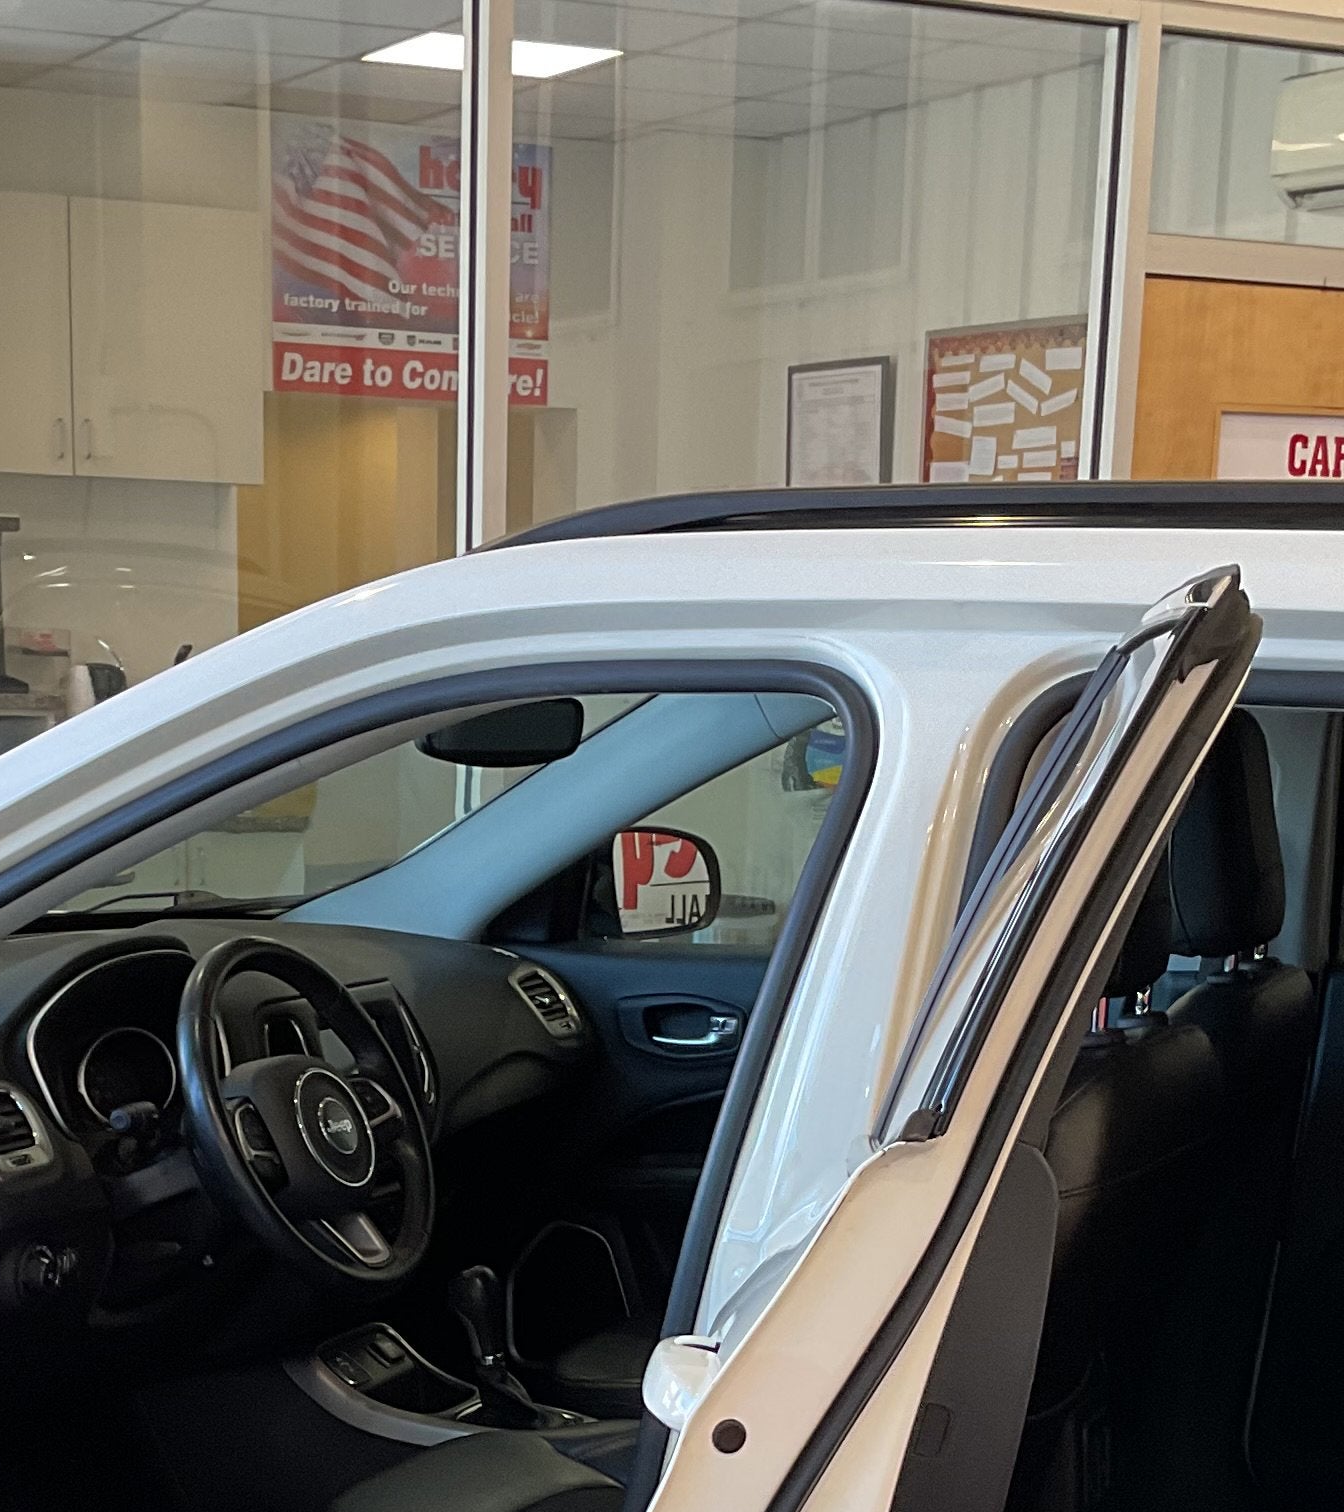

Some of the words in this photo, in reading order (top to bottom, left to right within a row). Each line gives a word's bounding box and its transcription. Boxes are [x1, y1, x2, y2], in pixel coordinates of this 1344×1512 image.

[417, 233, 539, 265] SECE
[388, 279, 418, 294] Our
[283, 293, 340, 312] factory
[345, 298, 401, 314] trained
[281, 352, 353, 385] Dare
[362, 358, 393, 387] to
[402, 360, 544, 396] Comre!
[327, 1119, 353, 1133] Jeep
